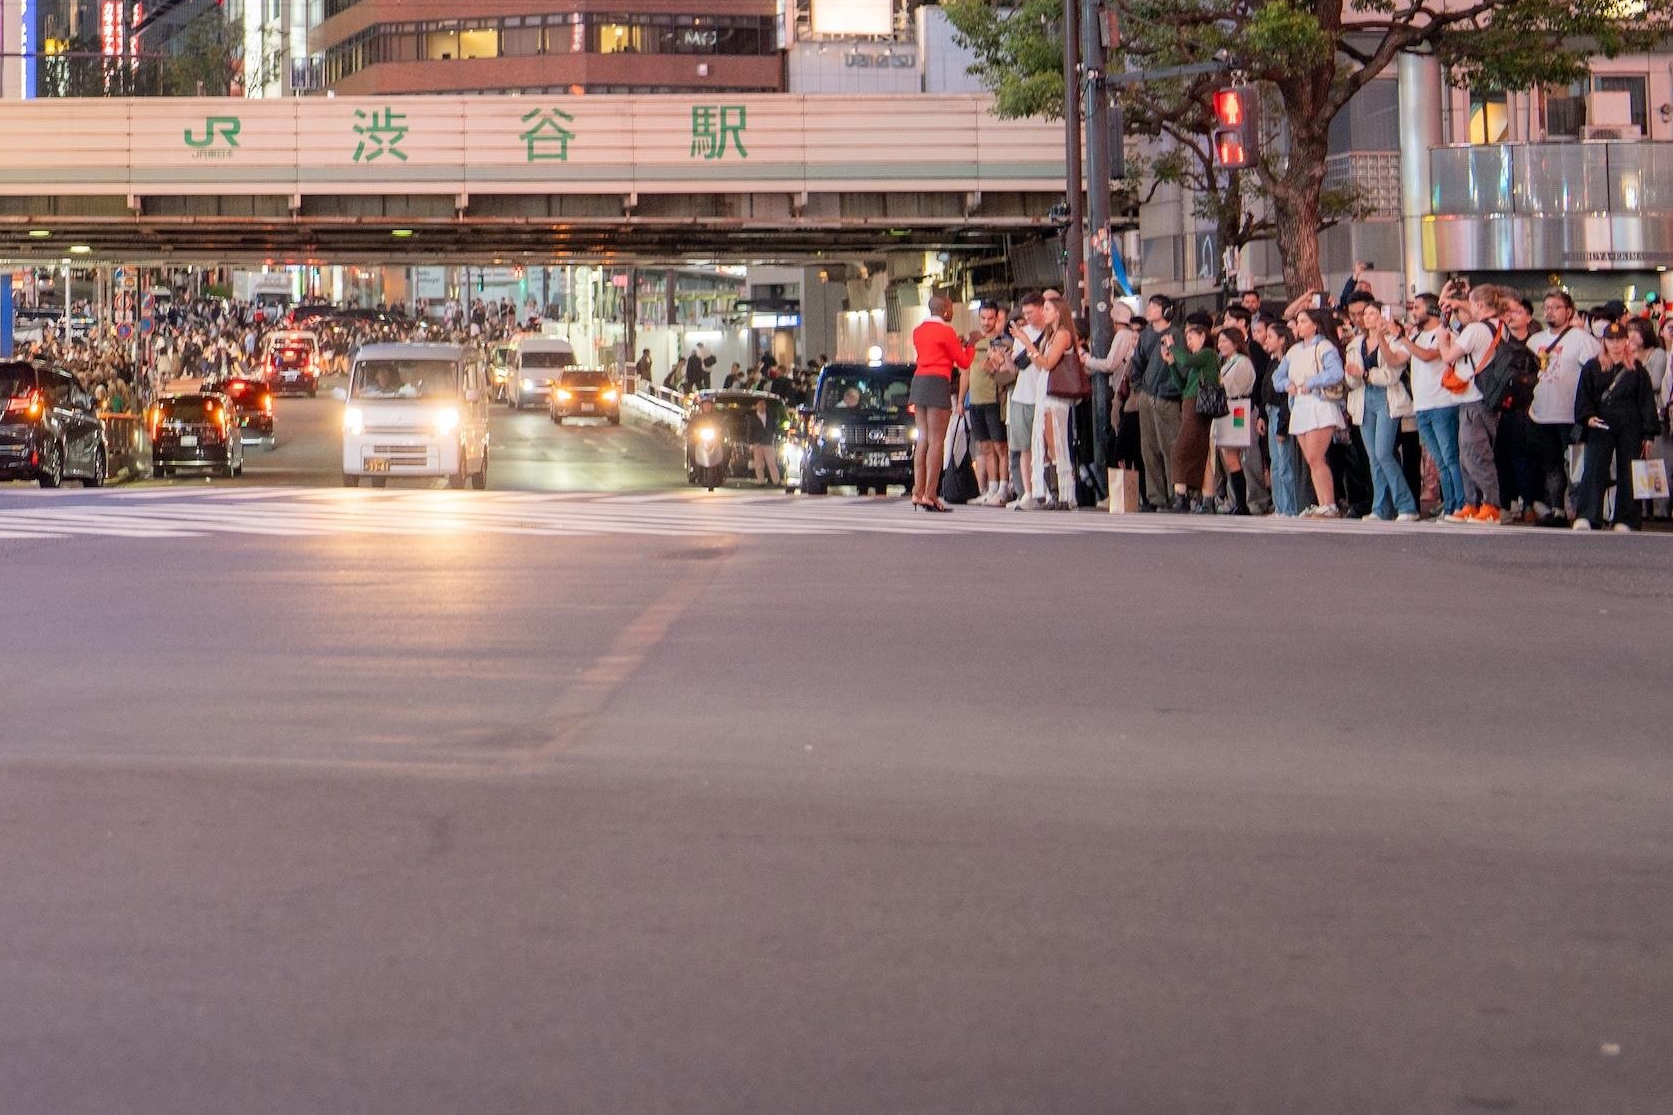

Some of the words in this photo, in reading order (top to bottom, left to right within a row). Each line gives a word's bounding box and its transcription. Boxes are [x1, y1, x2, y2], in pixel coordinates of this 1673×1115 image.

[183, 116, 241, 147] JR
[191, 149, 235, 160] JR東日本
